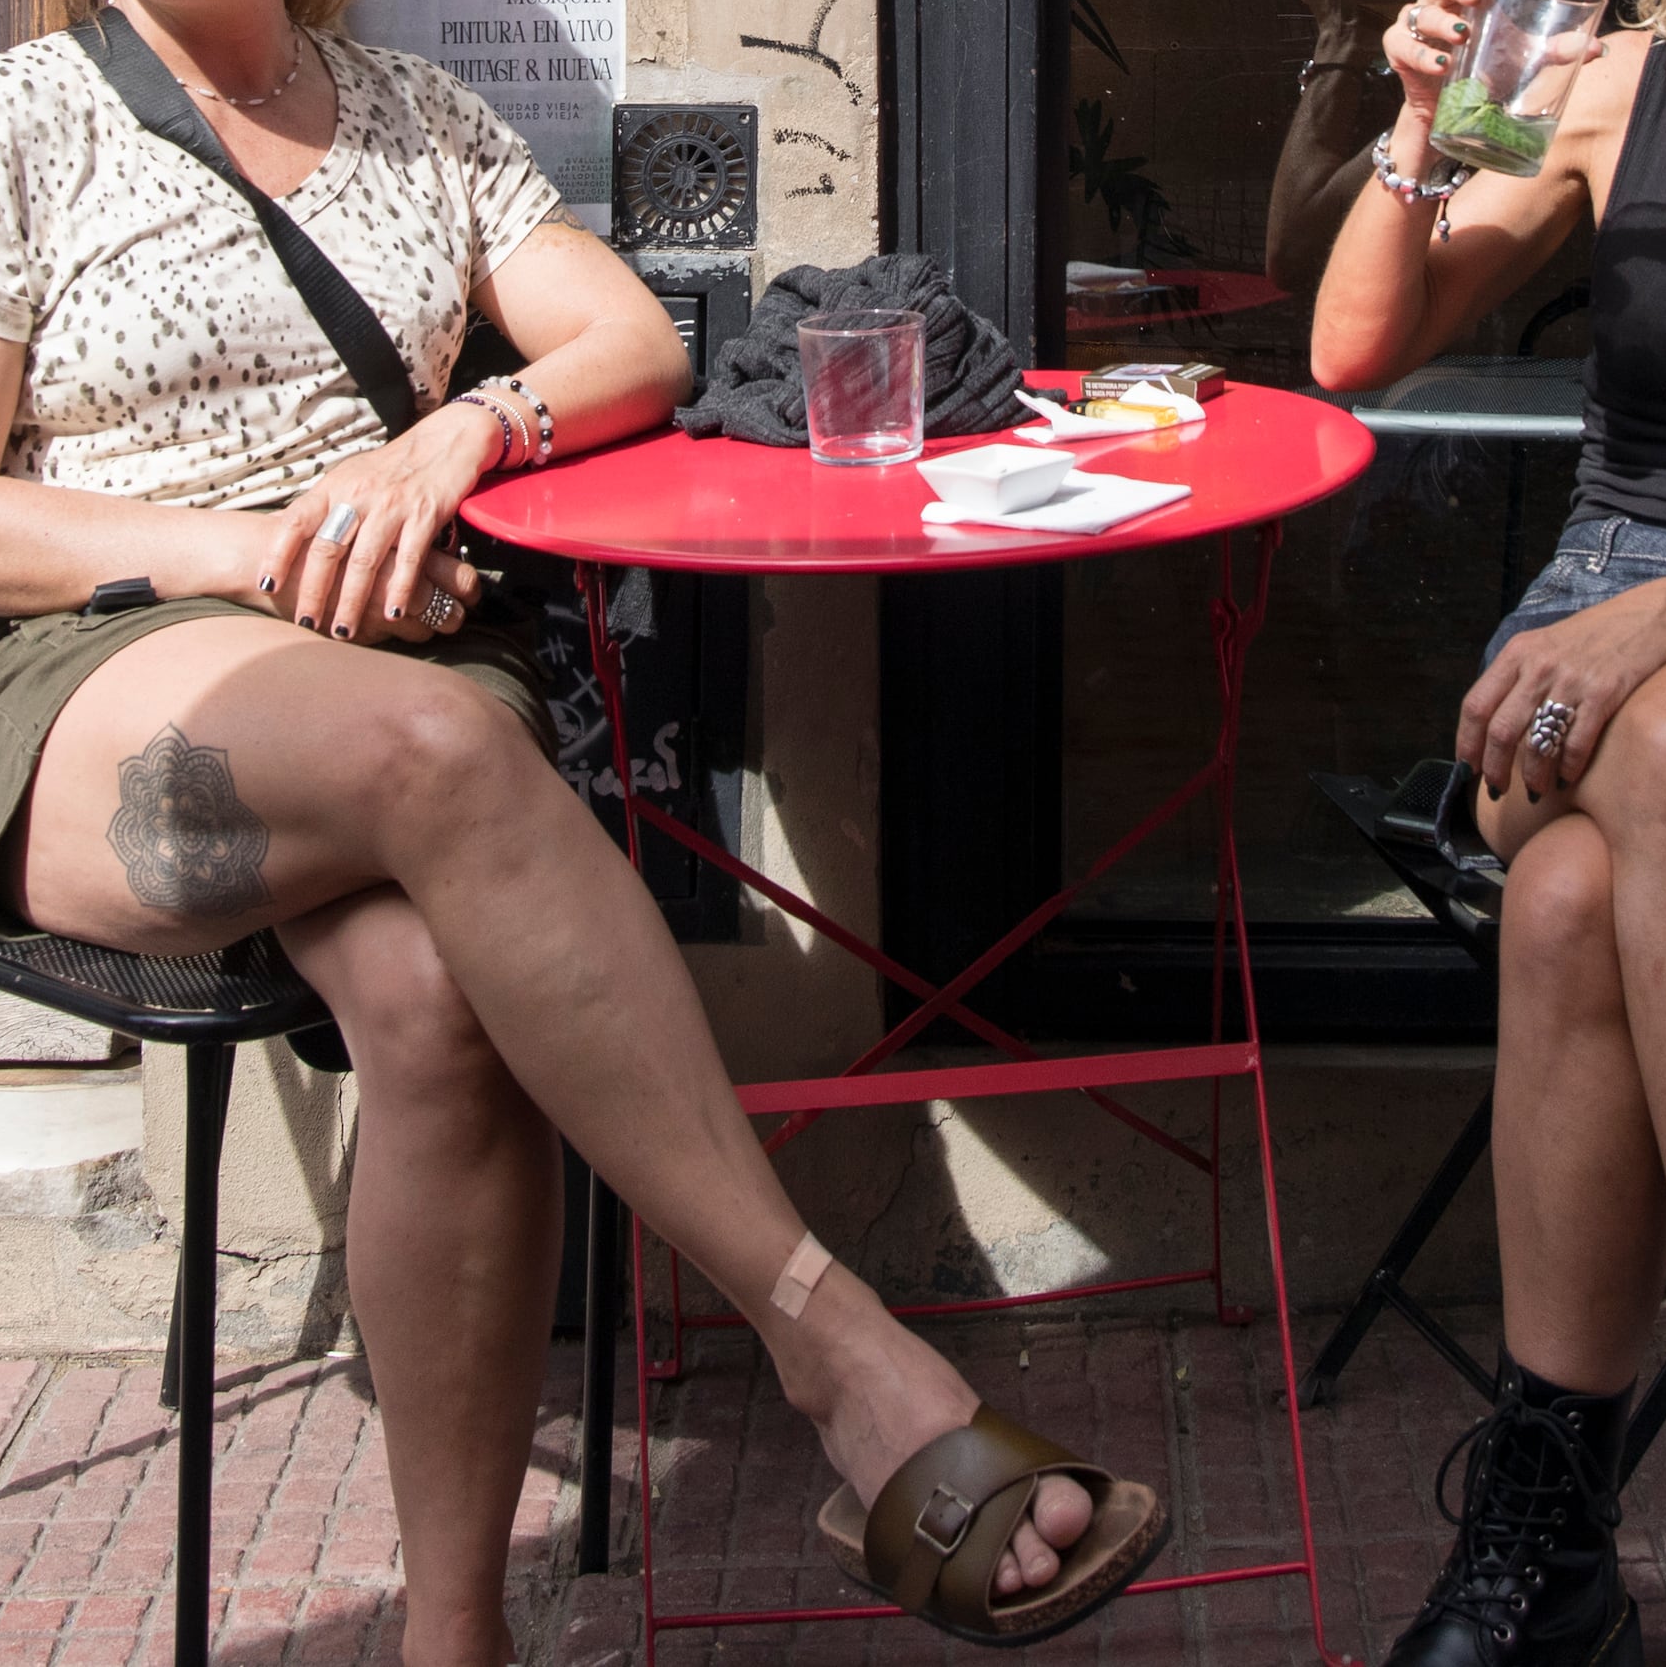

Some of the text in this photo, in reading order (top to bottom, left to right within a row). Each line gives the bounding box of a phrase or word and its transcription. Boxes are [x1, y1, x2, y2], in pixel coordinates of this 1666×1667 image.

[440, 19, 614, 45] PINTURA EN VIVO
[439, 57, 613, 83] VINTAGE & NUEVA
[493, 102, 541, 112] CIUDAD
[497, 111, 541, 121] IUDAD
